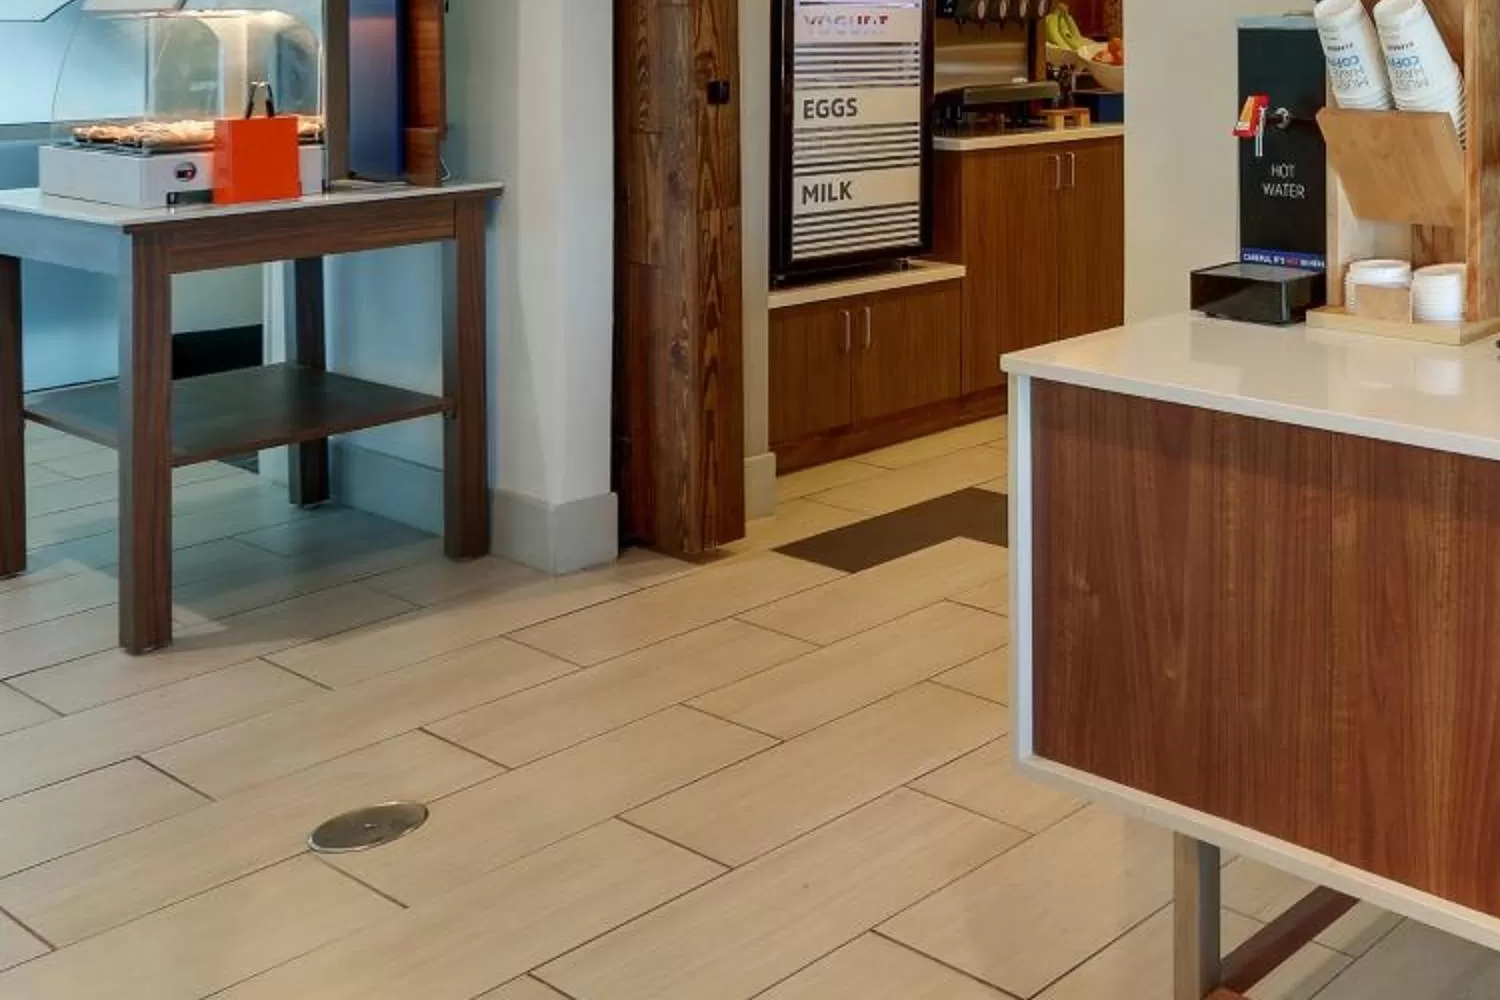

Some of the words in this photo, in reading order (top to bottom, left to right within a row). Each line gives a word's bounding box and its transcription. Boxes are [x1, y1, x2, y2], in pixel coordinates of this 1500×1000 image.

[802, 97, 858, 120] EGGS
[1271, 163, 1297, 179] HOT
[801, 181, 853, 205] MILK
[1262, 181, 1306, 199] WATER
